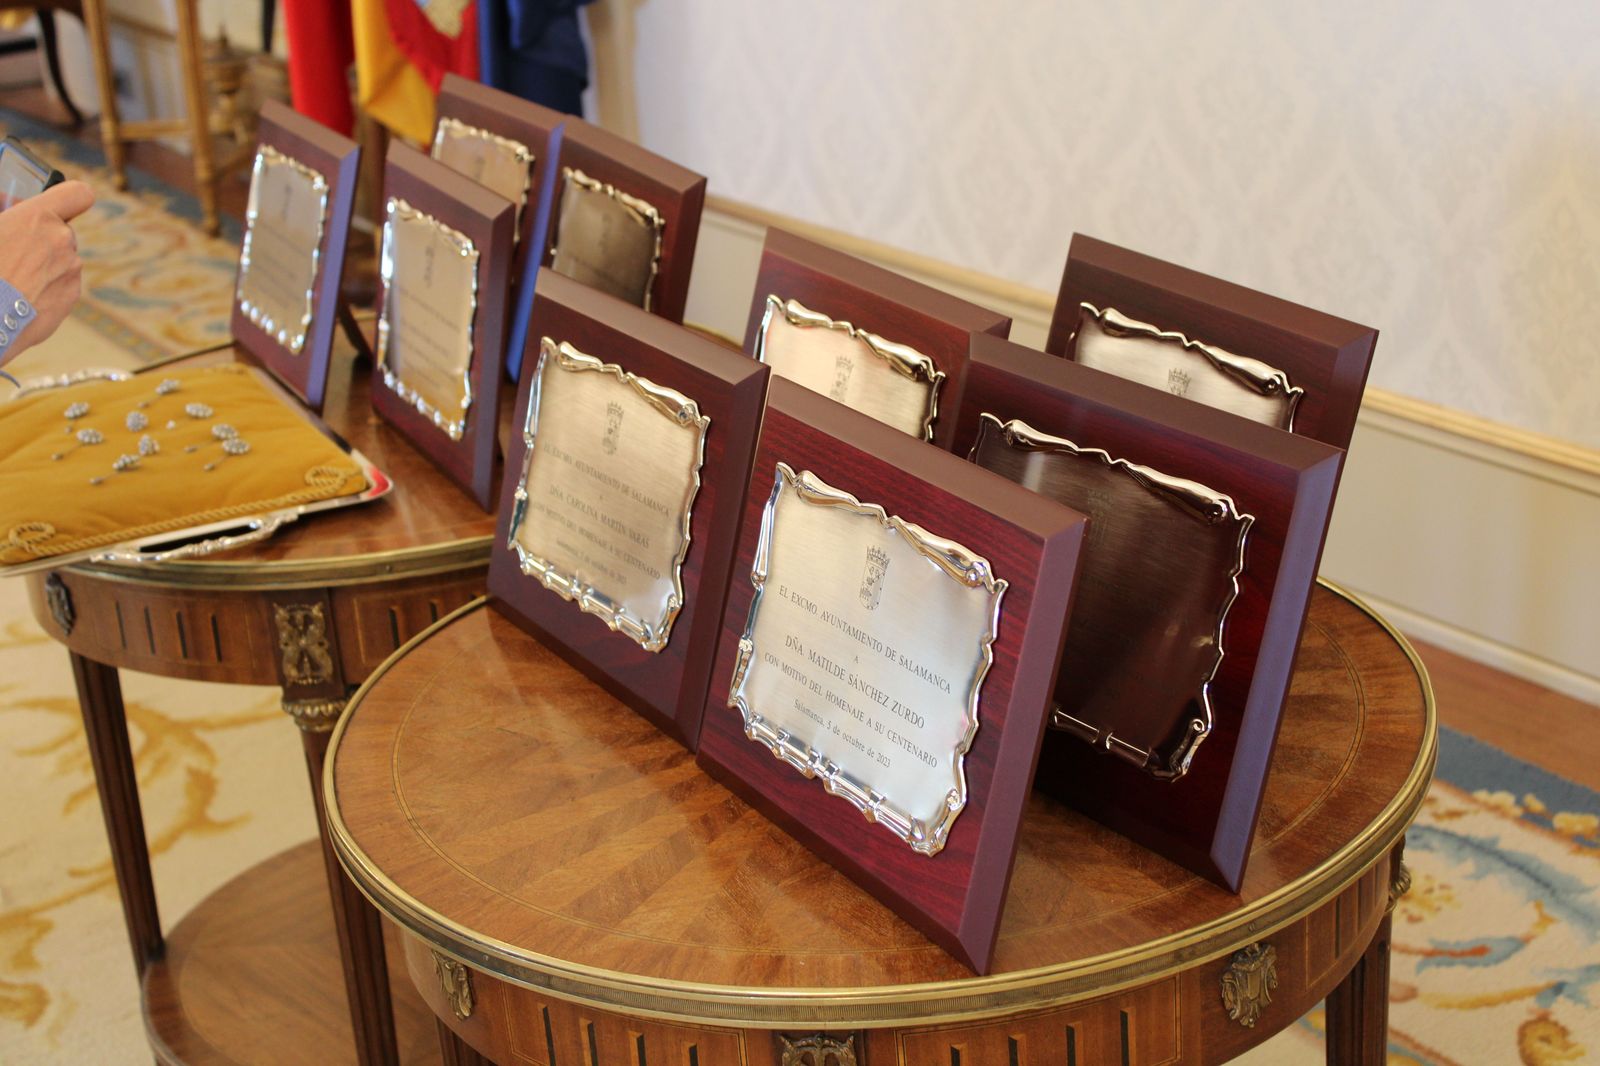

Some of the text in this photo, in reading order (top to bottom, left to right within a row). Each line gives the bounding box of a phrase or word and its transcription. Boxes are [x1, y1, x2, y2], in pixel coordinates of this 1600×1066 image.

[566, 494, 599, 520] CAROLINA
[631, 489, 670, 518] SALAMANCA
[623, 551, 660, 579] CENTENARIO
[779, 584, 789, 599] EL
[820, 610, 883, 653] AYUNTAMIENTO
[884, 646, 898, 662] DE
[898, 654, 951, 694] SALAMANCA
[854, 655, 860, 665] A
[764, 652, 938, 769] CON MOTIVO DEL HOMENAJE A SU CENTENARIO
[807, 648, 846, 681] MATILDE
[847, 673, 890, 708] SÁNCHEZ
[891, 699, 925, 729] ZURDO
[794, 699, 824, 727] Salamanca,
[832, 725, 841, 736] de
[842, 731, 866, 752] octubre
[866, 746, 876, 758] de
[876, 752, 891, 768] 2023
